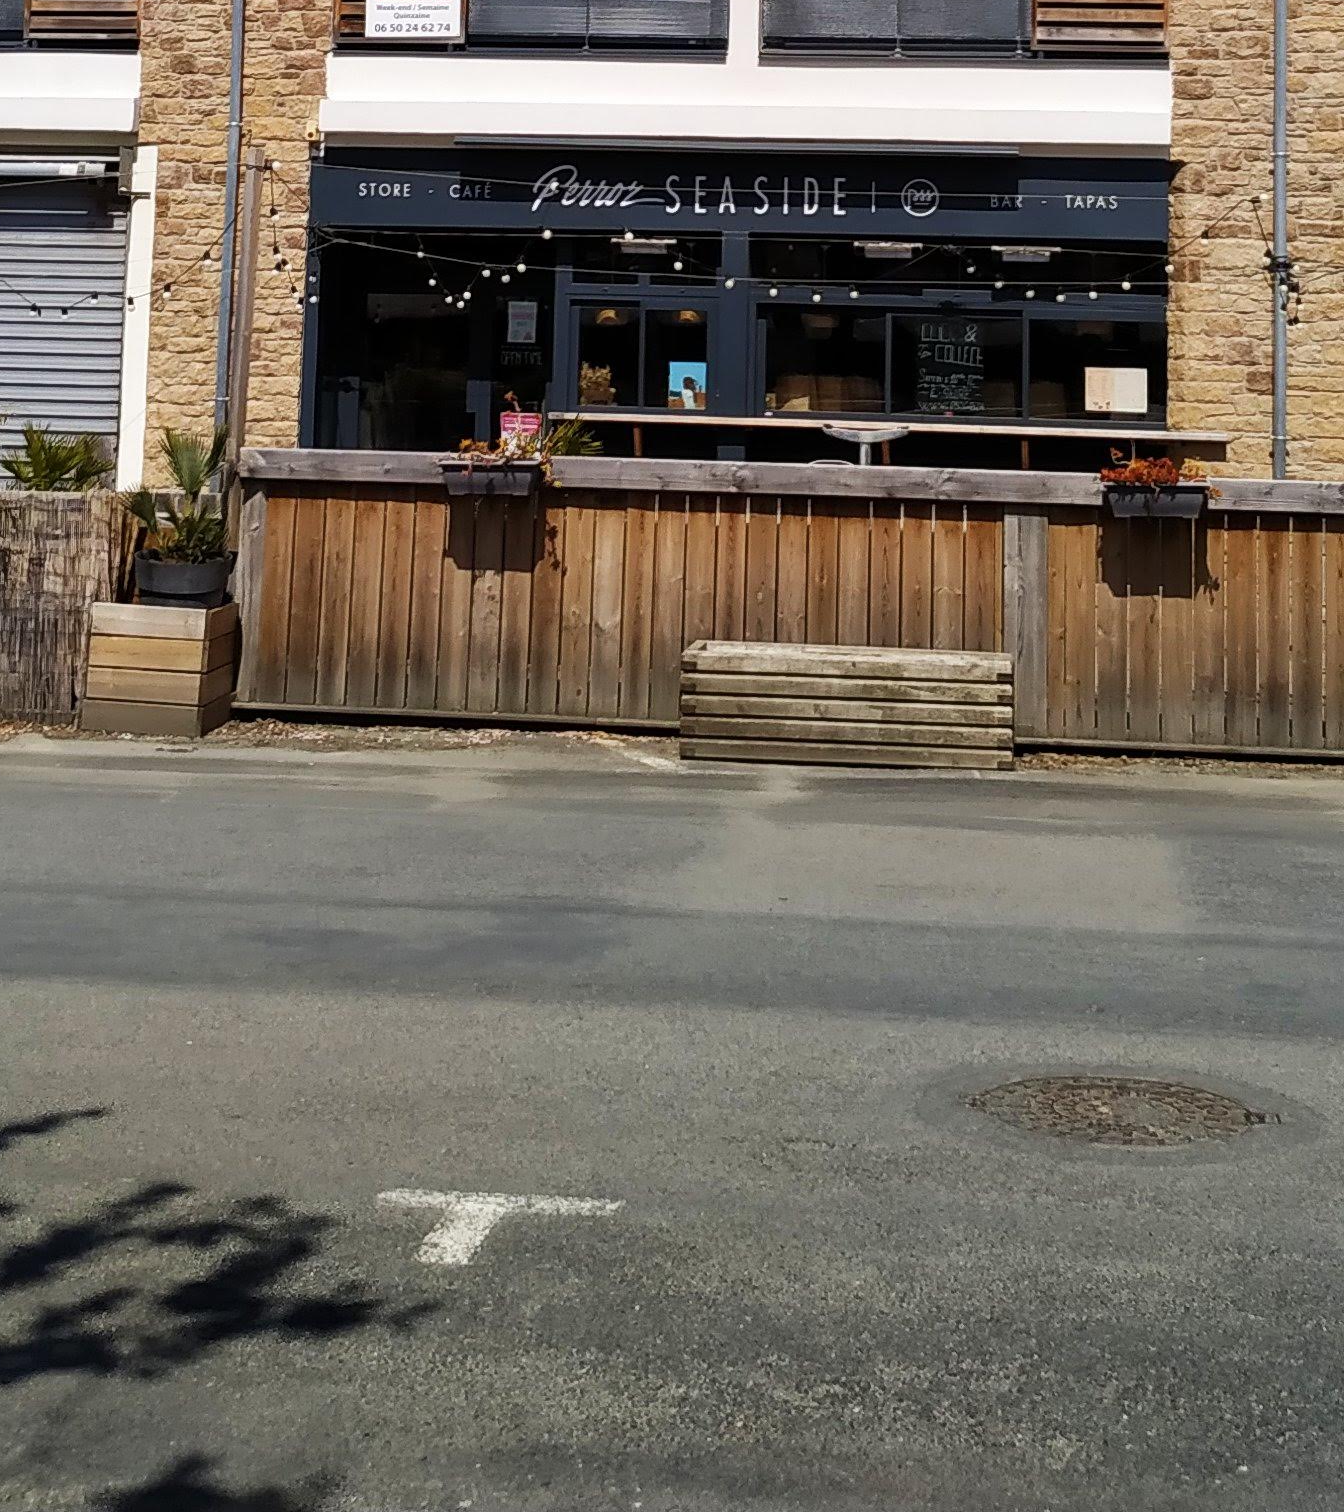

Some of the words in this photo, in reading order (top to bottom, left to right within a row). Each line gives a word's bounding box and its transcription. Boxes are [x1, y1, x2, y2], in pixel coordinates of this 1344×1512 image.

[374, 23, 388, 33] 06
[389, 23, 403, 33] 50
[405, 23, 419, 33] 24
[420, 23, 435, 33] 62
[437, 23, 451, 33] 74
[358, 182, 412, 198] STORE
[449, 181, 492, 199] CAFÉ
[989, 193, 1023, 209] BAR
[1065, 193, 1119, 210] TAPAS
